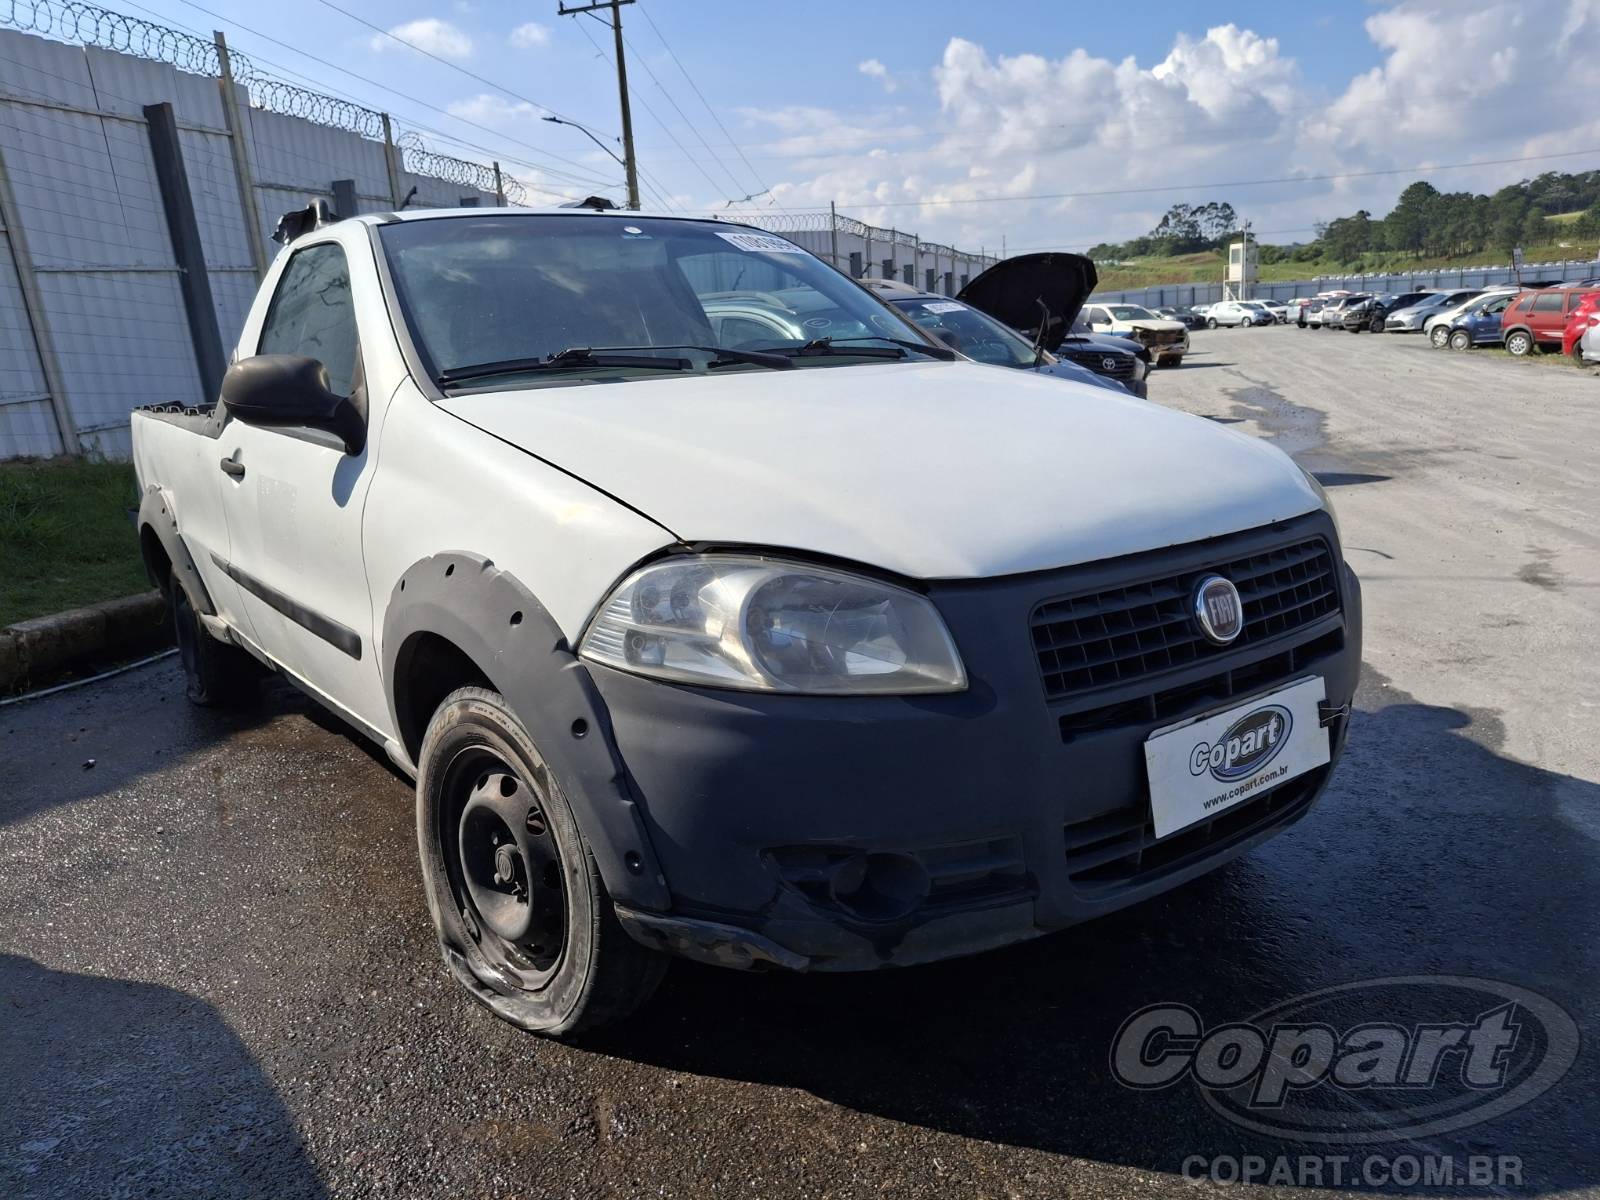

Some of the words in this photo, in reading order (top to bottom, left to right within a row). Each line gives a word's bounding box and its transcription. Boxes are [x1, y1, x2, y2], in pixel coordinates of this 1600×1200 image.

[1207, 593, 1236, 627] FIAT
[1189, 711, 1281, 777] Copart
[1202, 765, 1288, 810] www.copart.com.br
